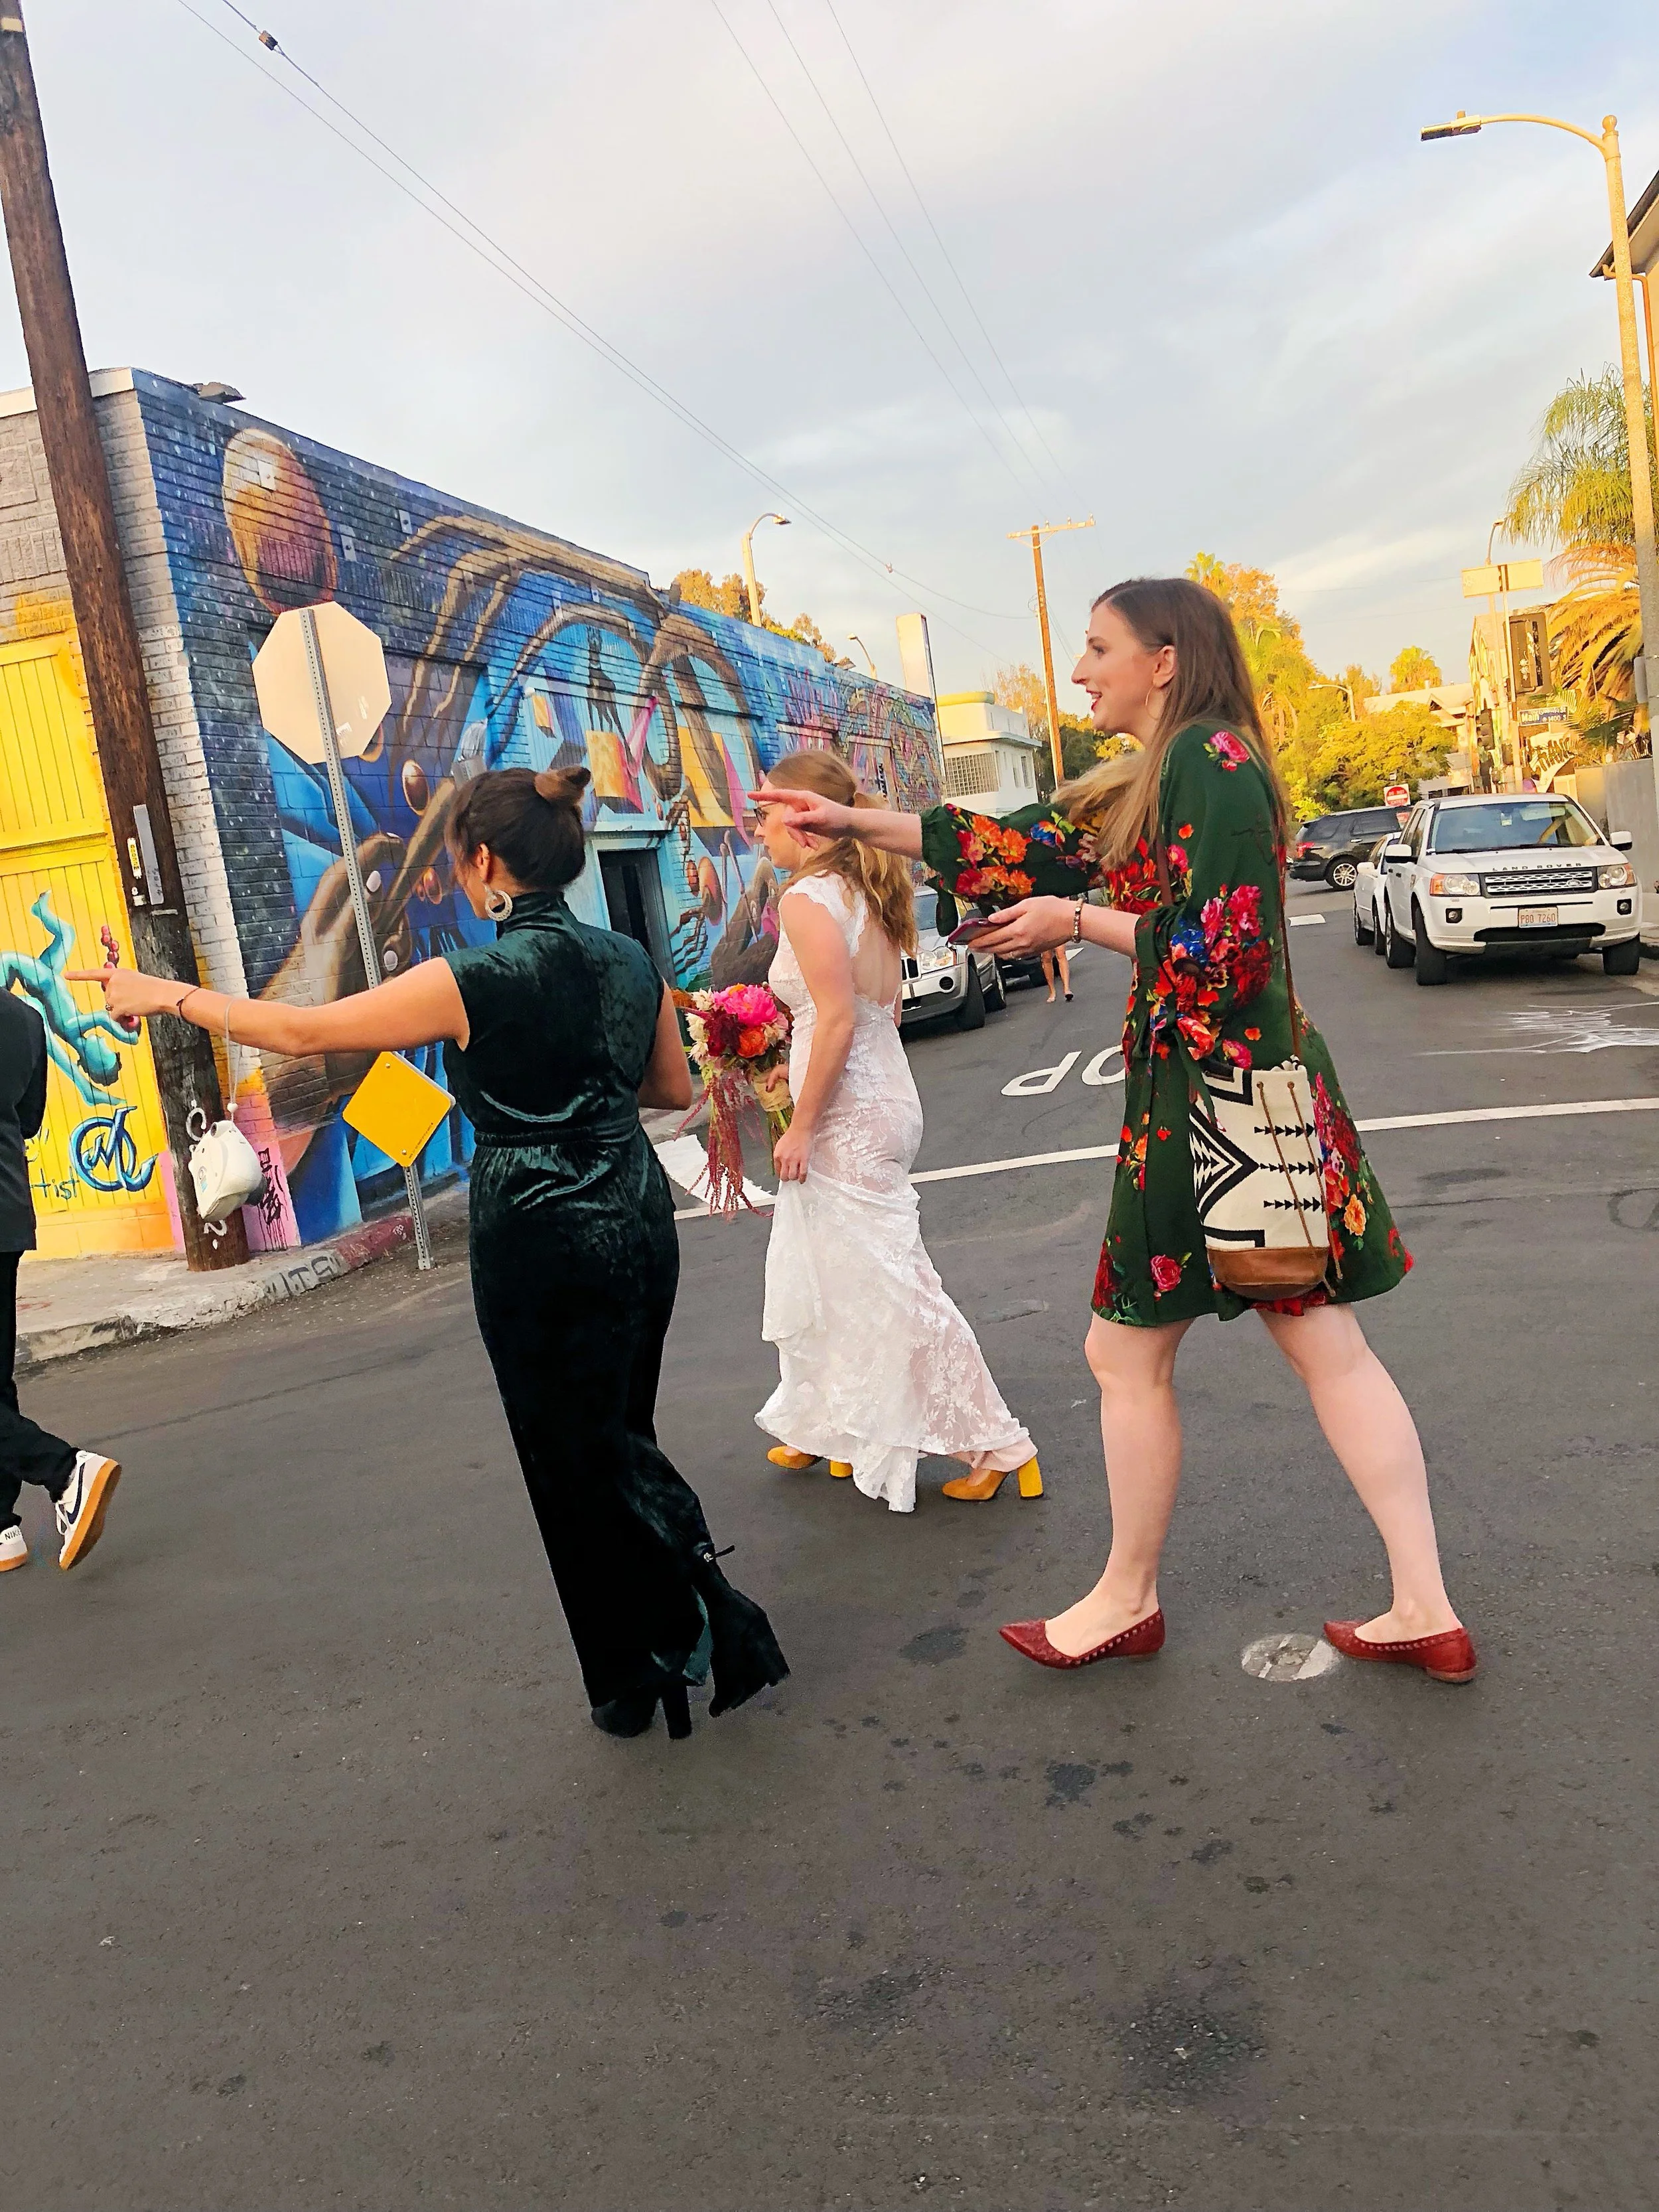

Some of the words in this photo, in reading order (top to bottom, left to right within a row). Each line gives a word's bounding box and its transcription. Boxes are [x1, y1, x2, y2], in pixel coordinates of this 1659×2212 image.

[1521, 712, 1540, 722] Main
[1538, 913, 1556, 923] 7260
[31, 1165, 80, 1200] tist
